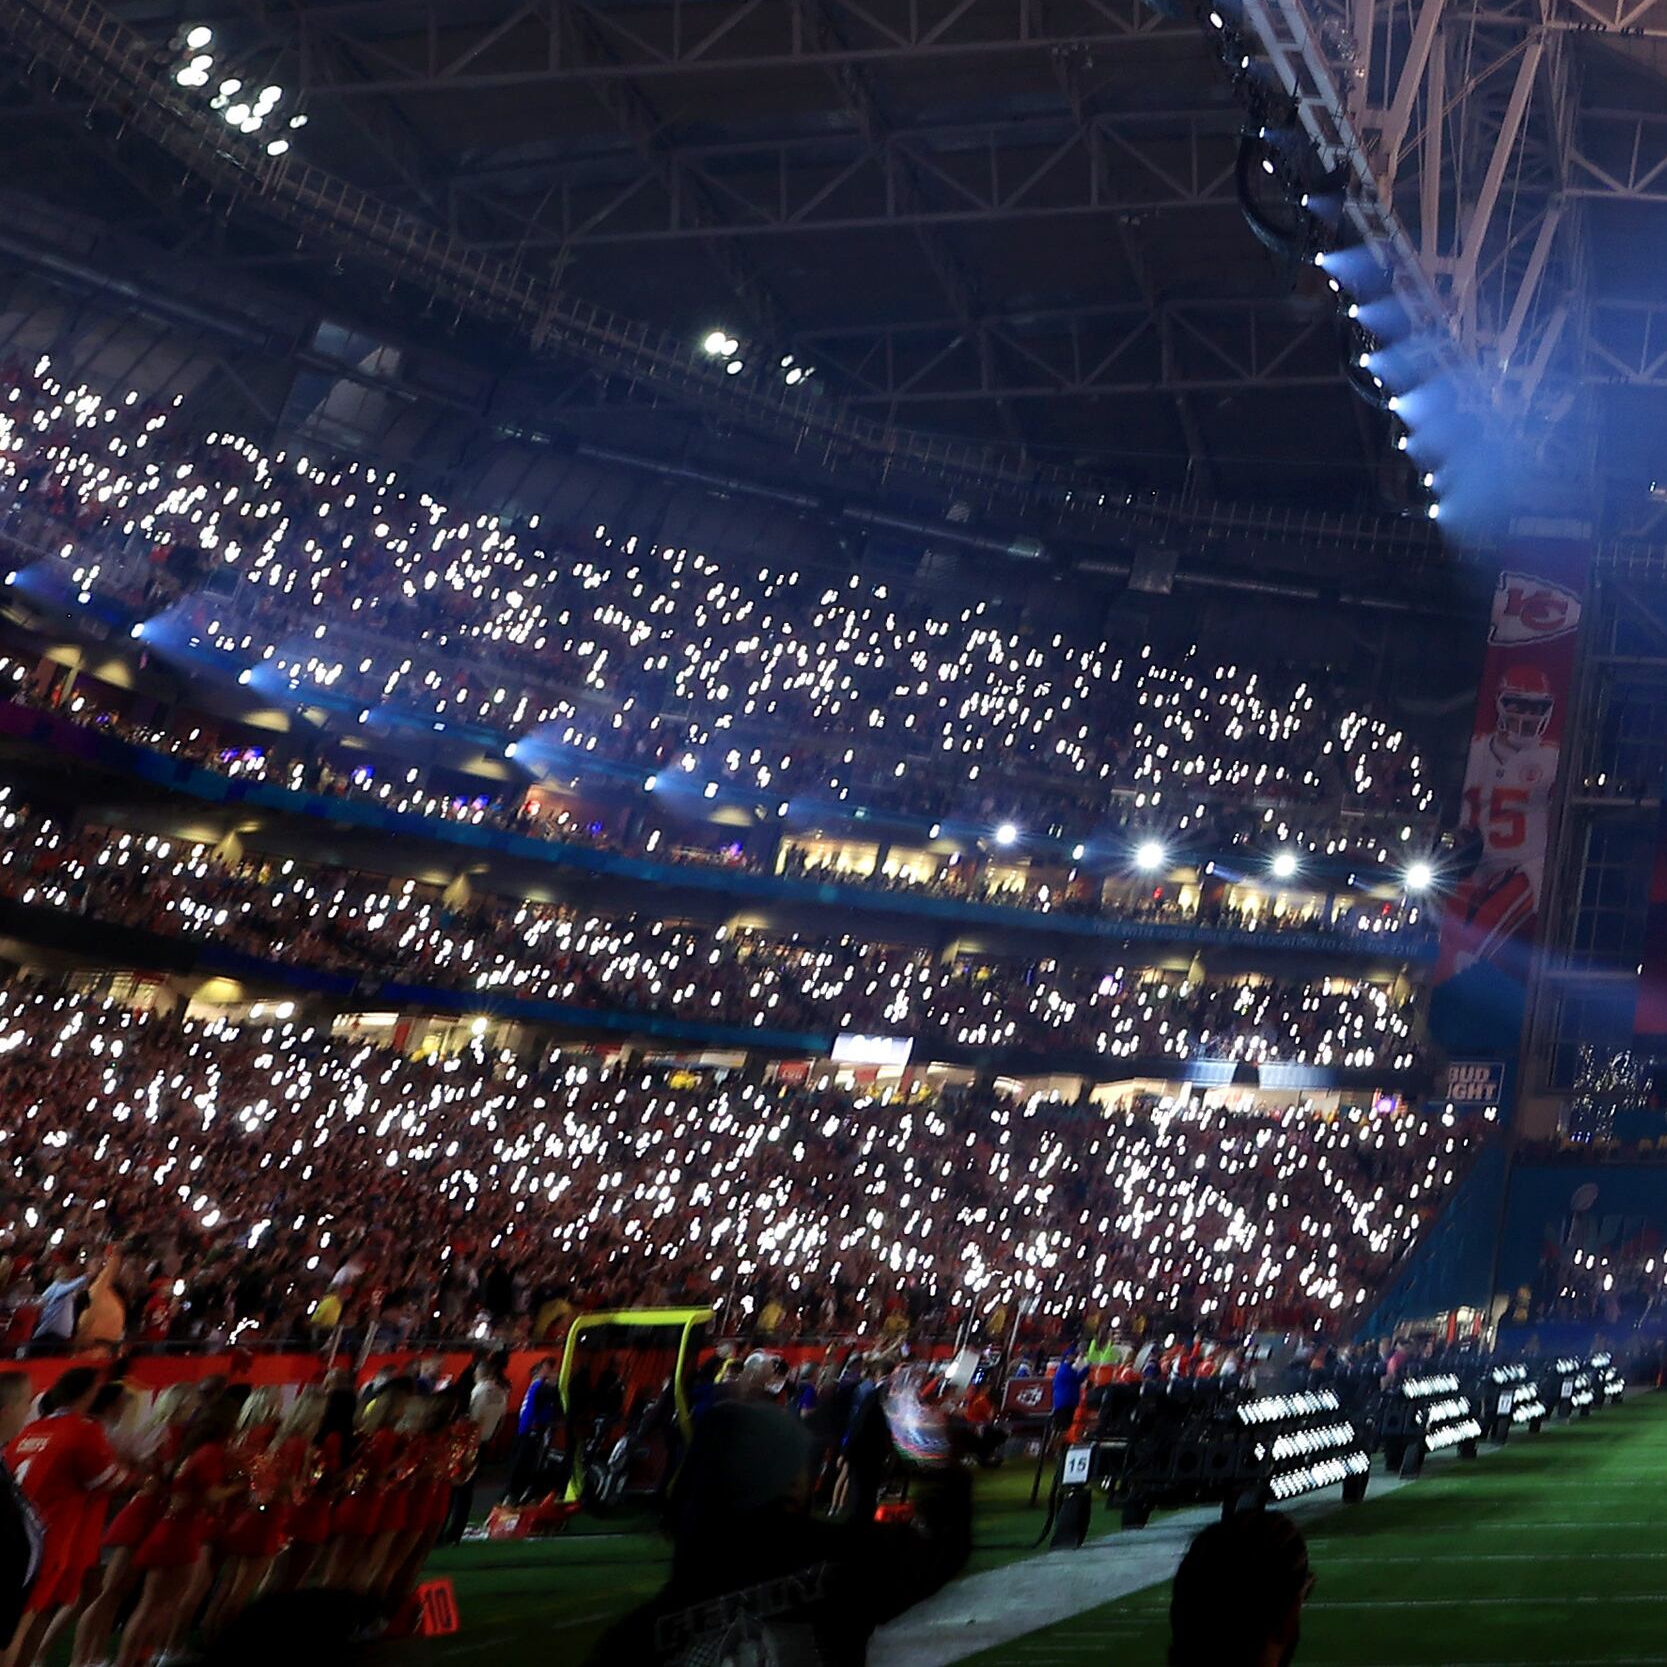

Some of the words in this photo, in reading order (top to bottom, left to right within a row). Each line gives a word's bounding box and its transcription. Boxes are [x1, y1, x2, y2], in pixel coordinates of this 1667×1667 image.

[1504, 587, 1569, 631] KC
[1463, 786, 1529, 850] 15
[1446, 1083, 1497, 1101] IGHT
[1069, 1457, 1088, 1474] 15
